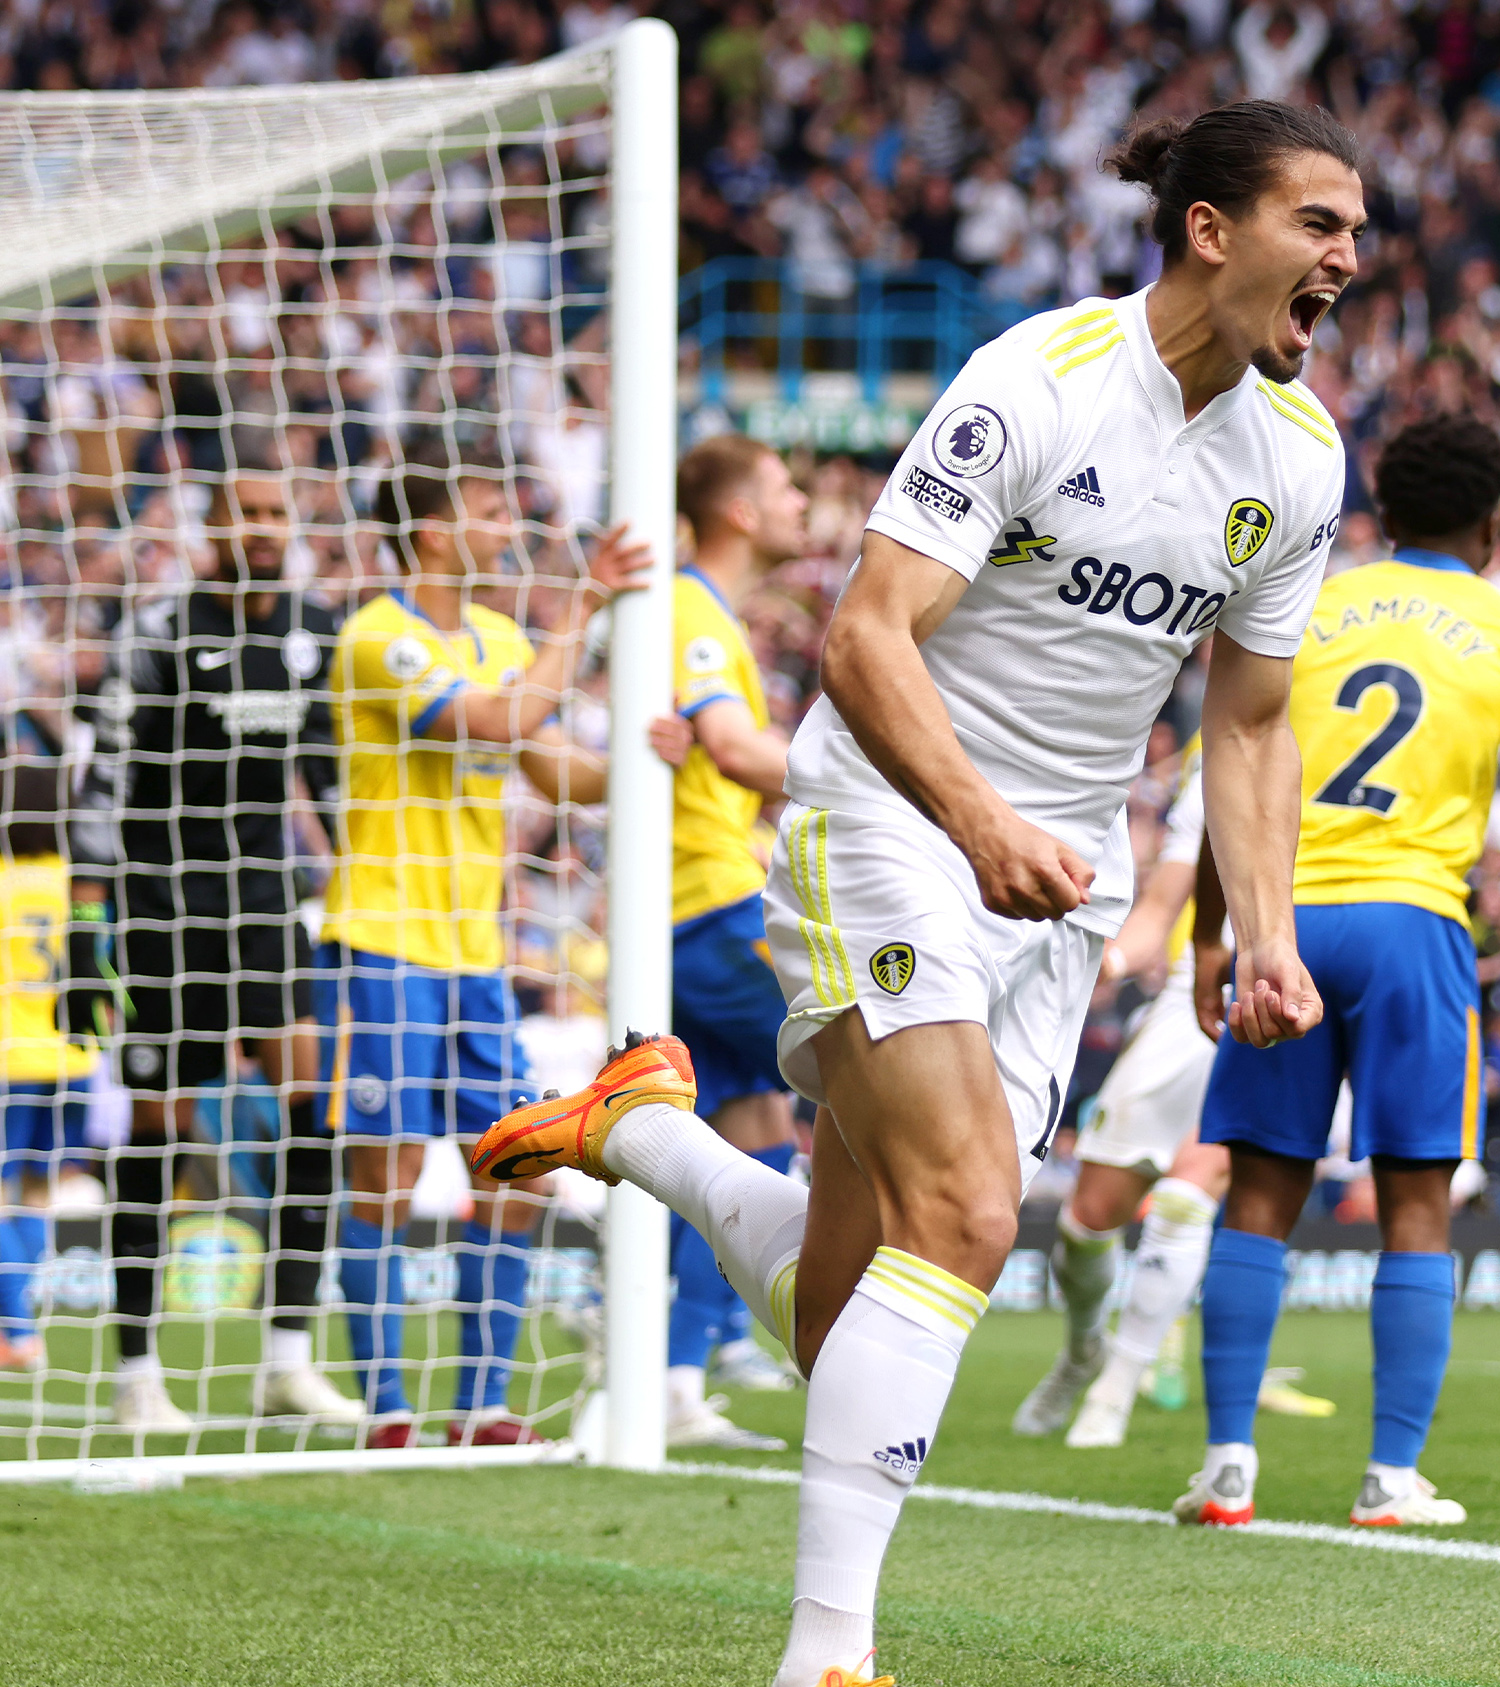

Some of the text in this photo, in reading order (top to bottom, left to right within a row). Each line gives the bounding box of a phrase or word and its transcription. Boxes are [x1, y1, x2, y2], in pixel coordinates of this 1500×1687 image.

[947, 453, 992, 472] Premier League
[900, 478, 965, 523] for racism
[907, 466, 965, 509] No room
[1057, 484, 1105, 508] adidas
[1057, 556, 1240, 636] SBOTO
[1311, 597, 1490, 657] LAMPTEY
[1315, 663, 1423, 813] 2
